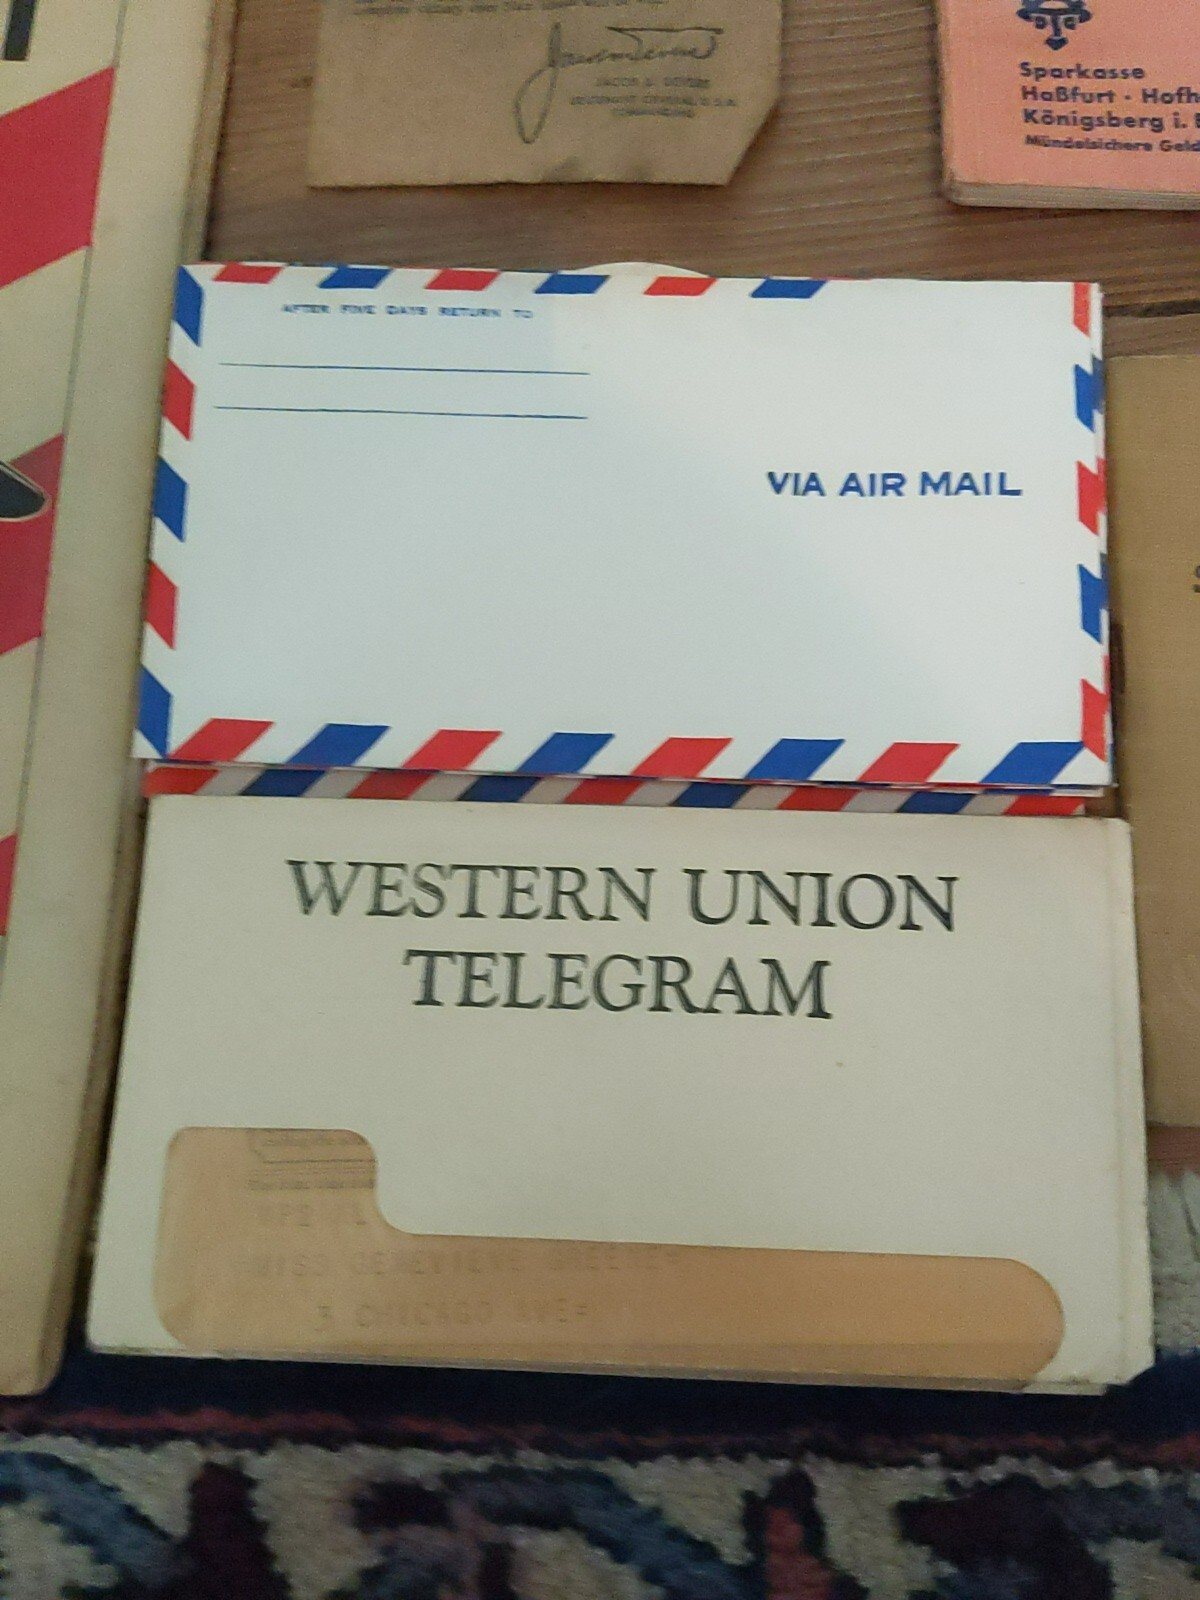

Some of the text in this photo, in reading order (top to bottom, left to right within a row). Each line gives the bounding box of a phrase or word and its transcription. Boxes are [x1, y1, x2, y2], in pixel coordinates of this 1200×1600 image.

[1019, 61, 1145, 82] Sparkasse
[1021, 86, 1115, 104] Haßfurt
[1023, 108, 1165, 133] Königsberg
[281, 303, 534, 319] AFTER FIVE DAYS RETURN TO
[766, 470, 1023, 497] VIA AIR MAIL
[286, 859, 960, 932] WESTERN UNION
[402, 948, 833, 1019] TELEGRAM
